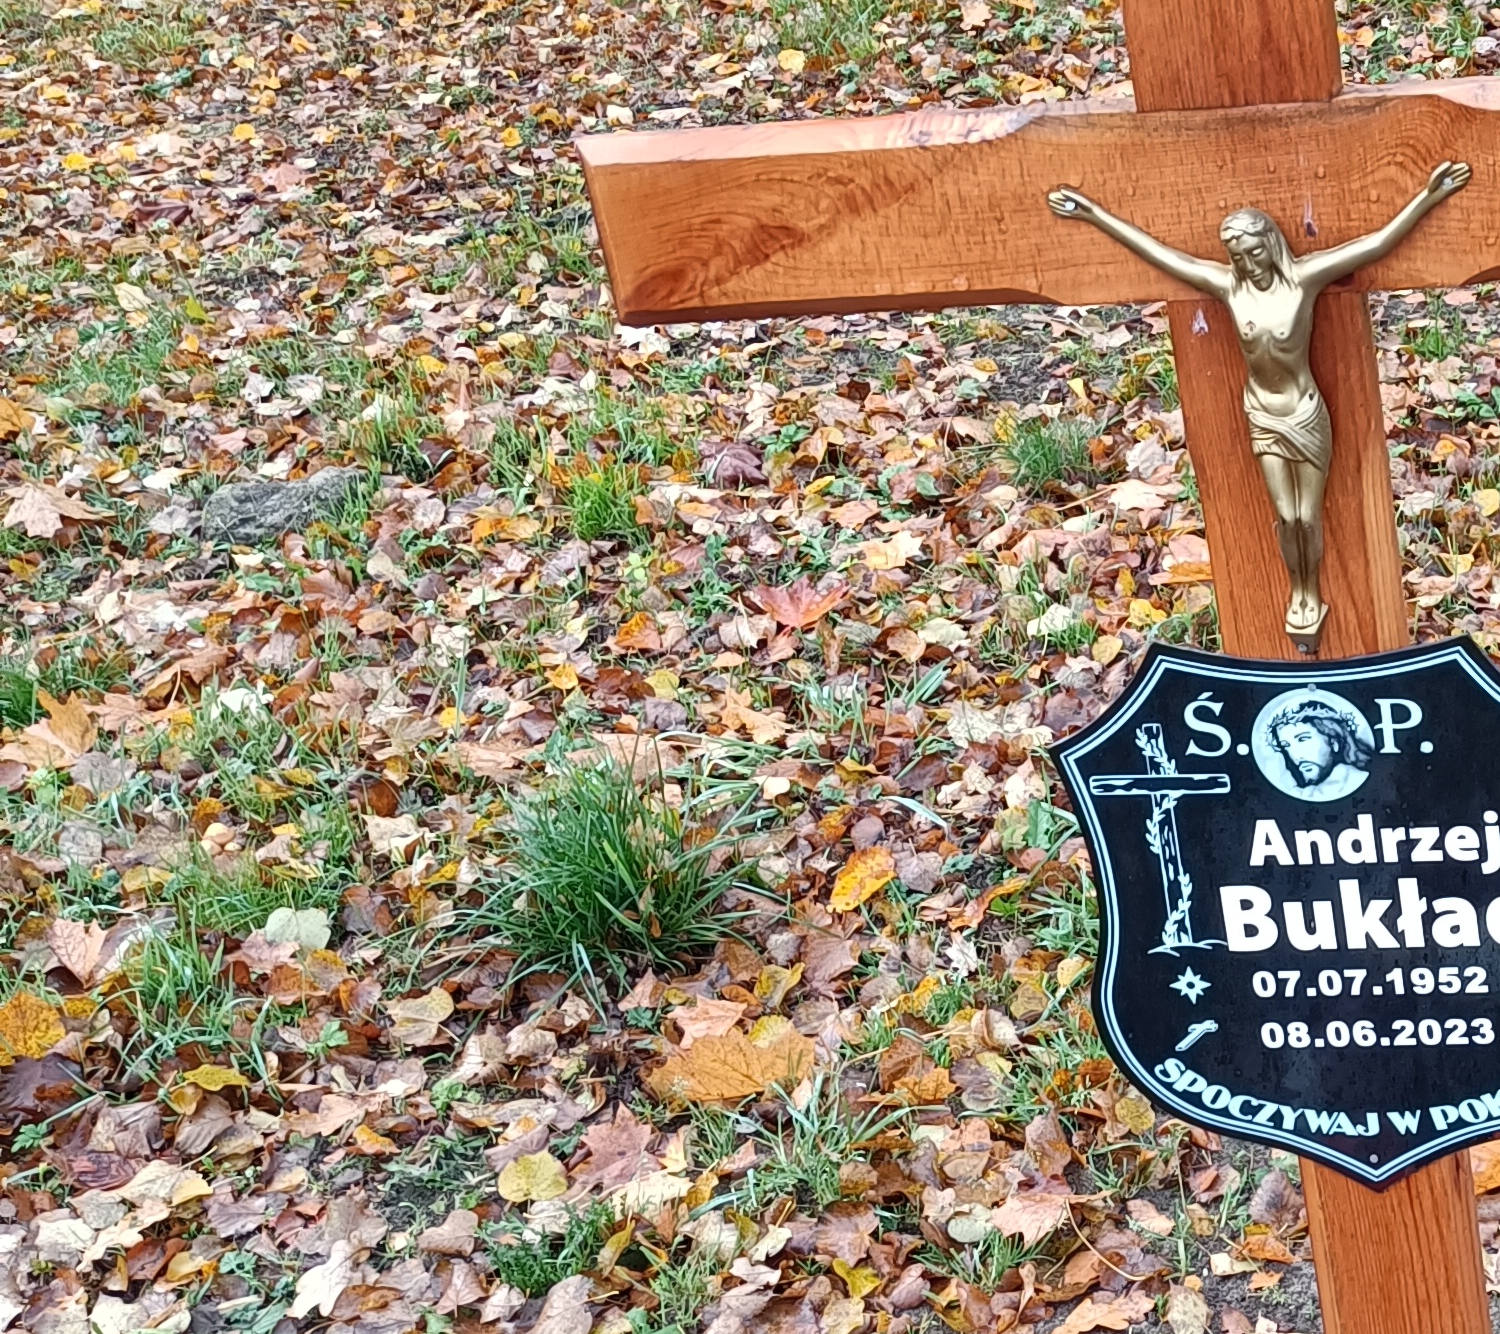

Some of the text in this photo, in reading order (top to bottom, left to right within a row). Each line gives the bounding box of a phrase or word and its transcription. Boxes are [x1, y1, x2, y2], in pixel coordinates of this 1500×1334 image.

[1183, 691, 1434, 757] Ś. P.
[1252, 966, 1489, 998] 07.07.1952
[1260, 1017, 1496, 1049] 08.06.2023
[1153, 1057, 1381, 1137] SPOCZYWAJ
[1386, 1109, 1421, 1135] W
